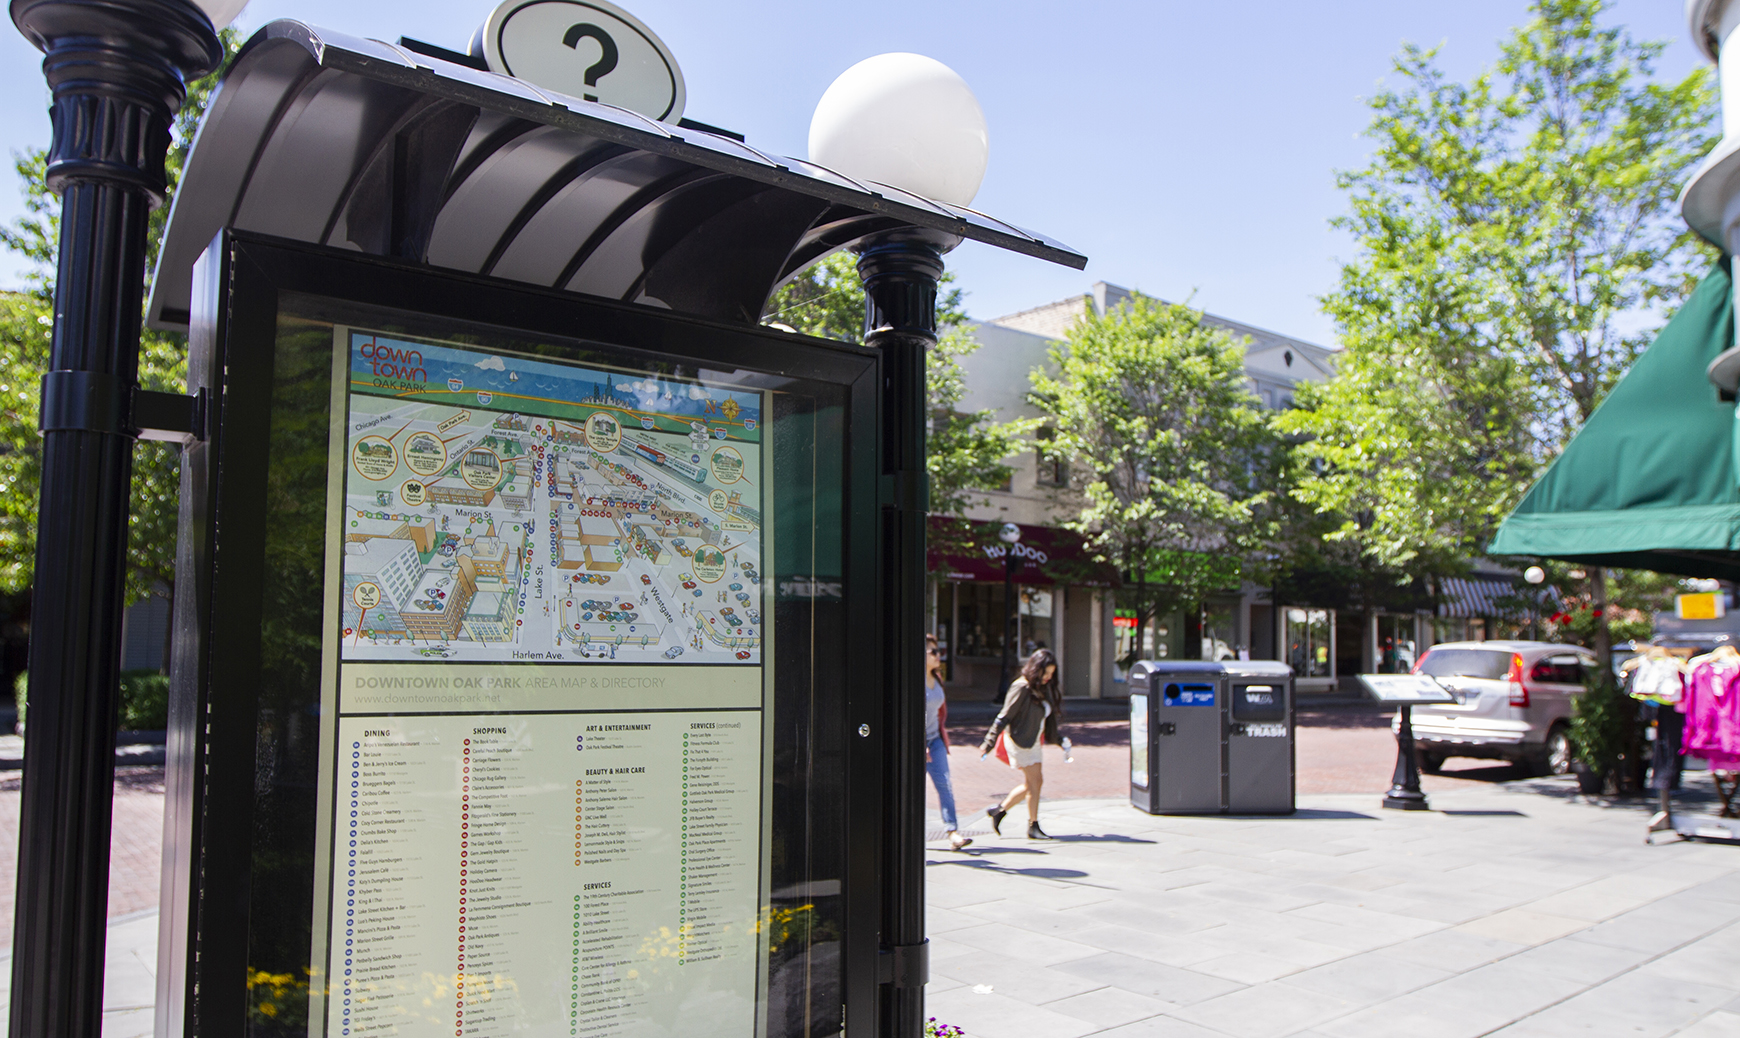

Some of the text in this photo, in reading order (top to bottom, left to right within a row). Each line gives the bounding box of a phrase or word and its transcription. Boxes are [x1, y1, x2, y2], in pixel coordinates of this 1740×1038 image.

[562, 23, 618, 103] ?
[361, 336, 422, 365] down
[369, 357, 427, 382] town
[373, 378, 426, 393] OAK PARK
[705, 399, 717, 414] N
[355, 420, 379, 430] Chicago
[450, 445, 468, 459] Ontario
[656, 482, 672, 496] North
[673, 493, 686, 504] Blvd.
[456, 509, 482, 518] Marion
[661, 510, 683, 518] Marion
[651, 587, 673, 624] Westgate
[512, 651, 544, 659] Harlem
[356, 677, 666, 688] DOWNTOWN OAK PARK AREA MAP & DIRECTORY
[354, 693, 500, 704] www.downtownoakpark.net
[1246, 727, 1286, 737] TRASH
[584, 882, 611, 890] SERVICES
